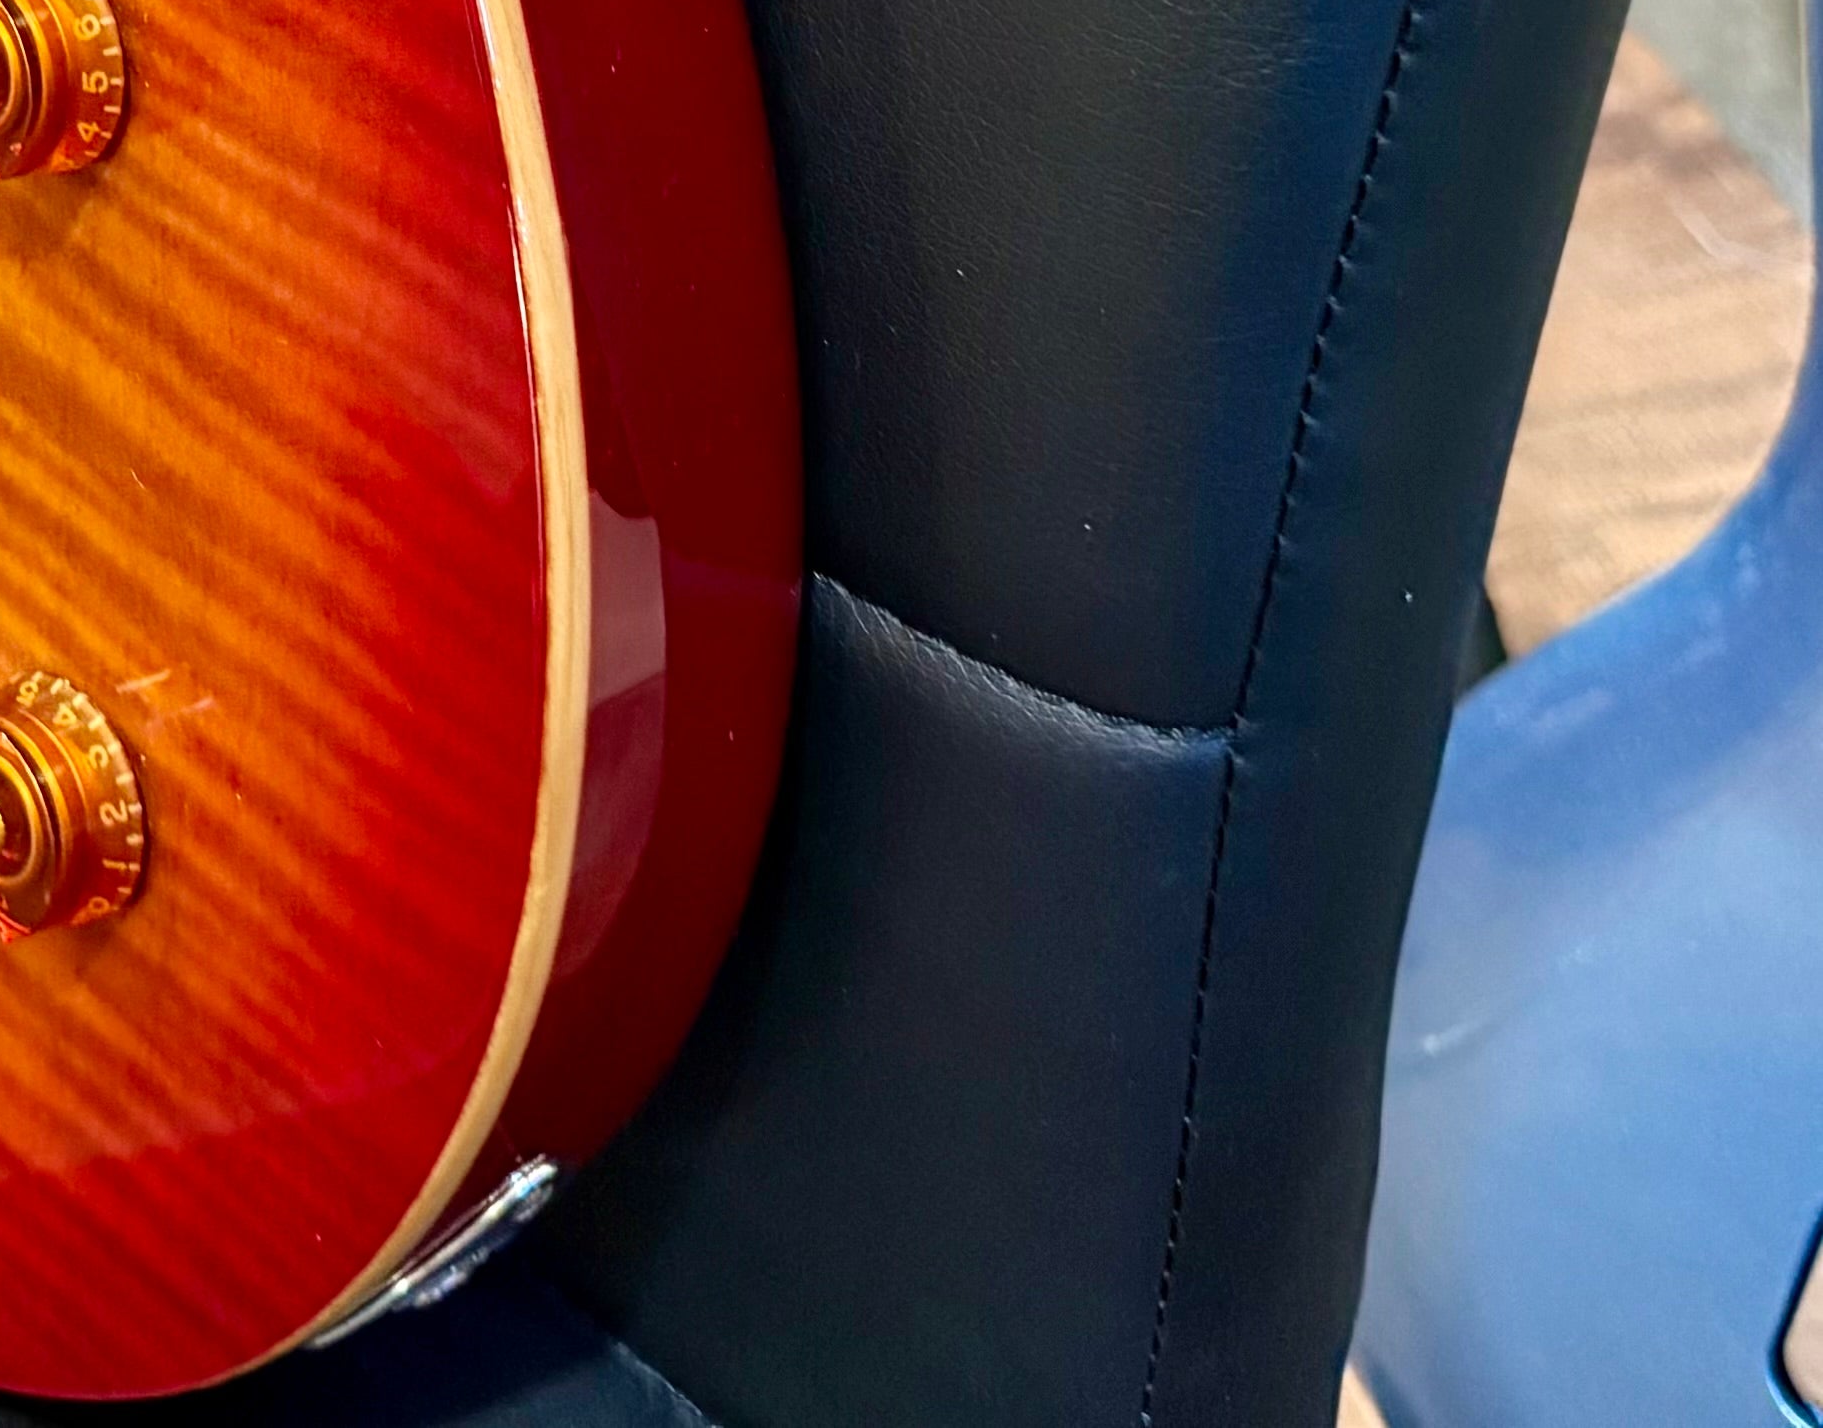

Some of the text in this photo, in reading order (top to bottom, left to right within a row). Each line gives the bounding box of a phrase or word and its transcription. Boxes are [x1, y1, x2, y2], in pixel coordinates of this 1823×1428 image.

[82, 71, 108, 93] 5
[77, 122, 100, 142] 4
[99, 799, 128, 827] 2
